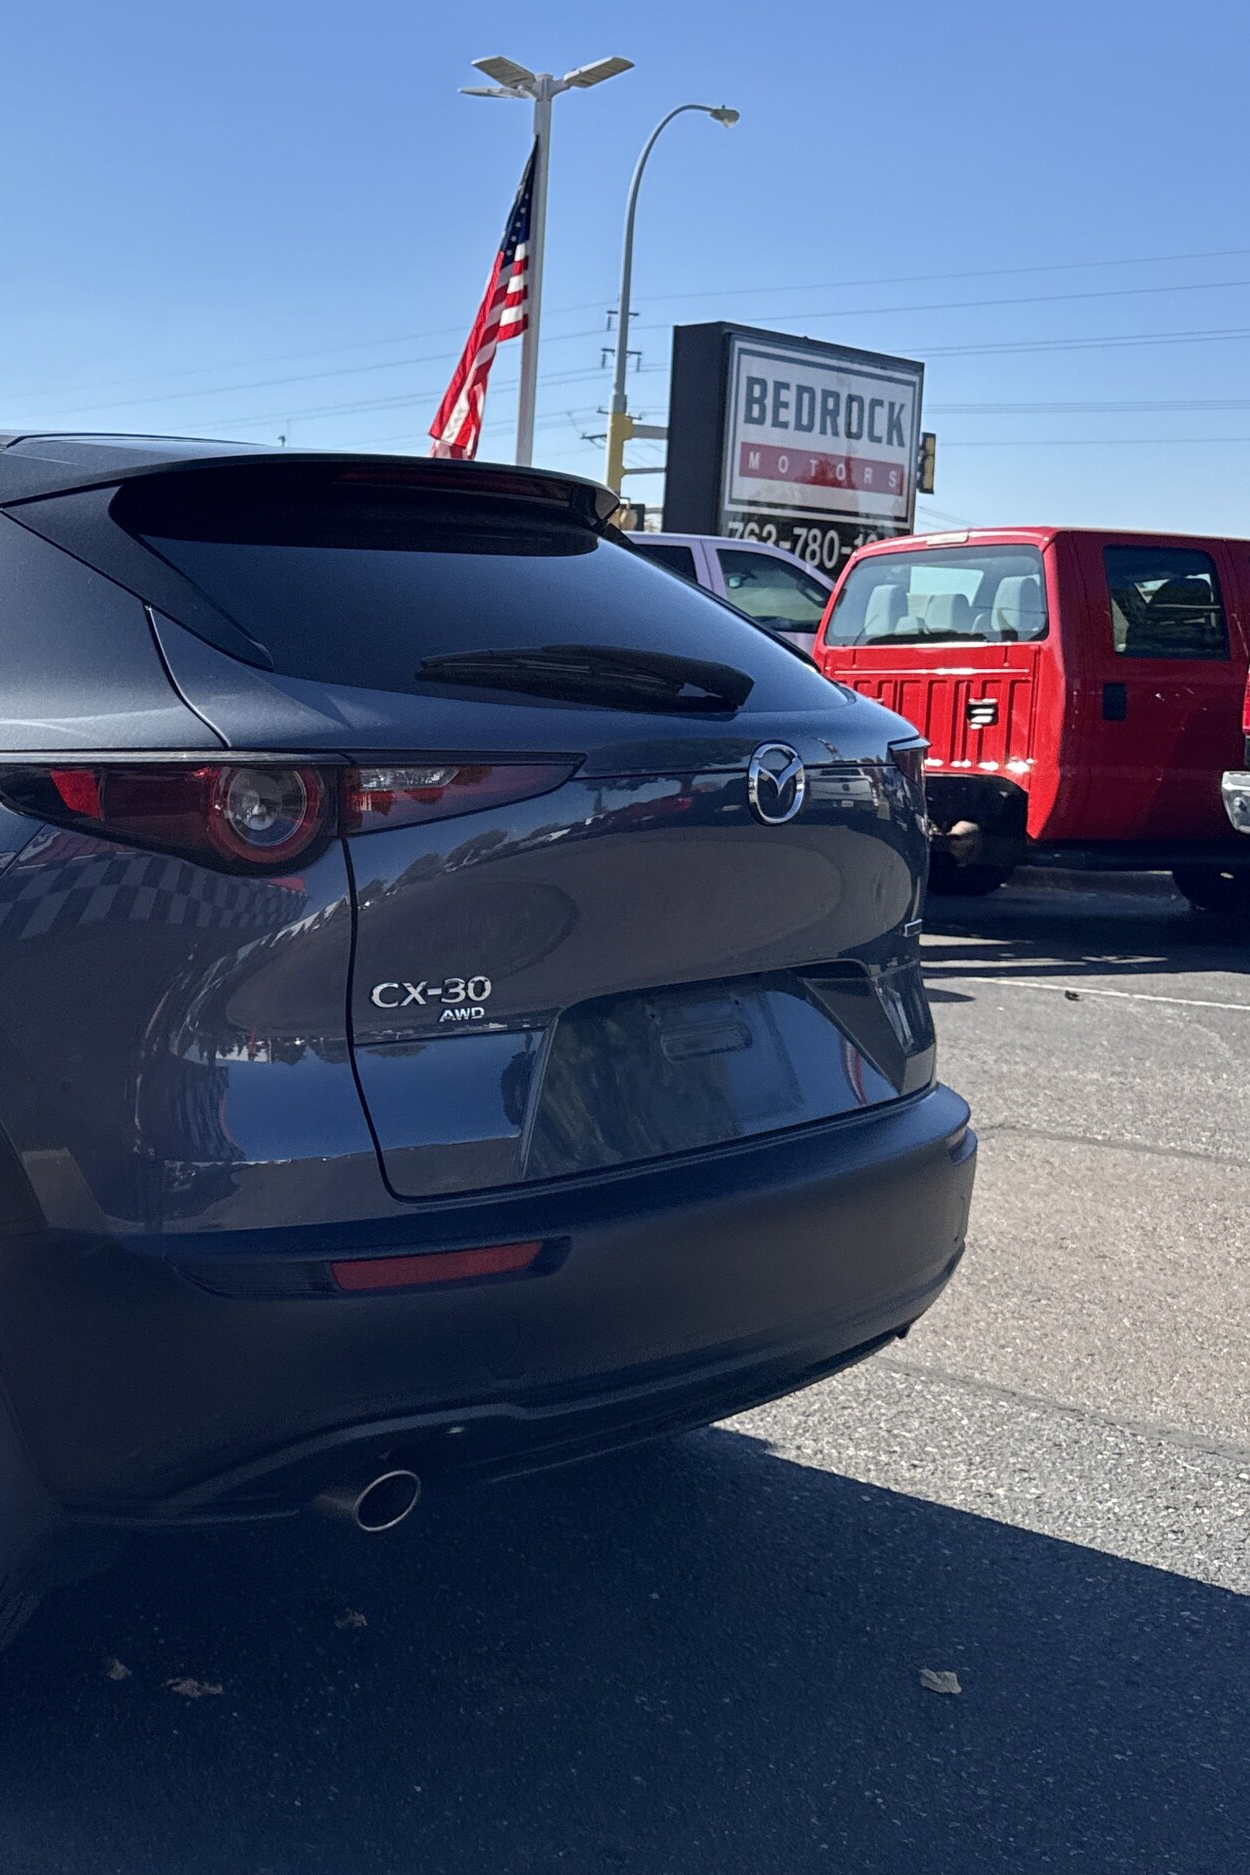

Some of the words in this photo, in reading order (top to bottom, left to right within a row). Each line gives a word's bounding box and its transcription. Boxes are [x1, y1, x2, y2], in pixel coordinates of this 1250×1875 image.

[743, 376, 906, 448] BEDROCK
[748, 451, 897, 488] MOTORS
[370, 975, 492, 1008] CX-30
[439, 1006, 485, 1022] AWD
